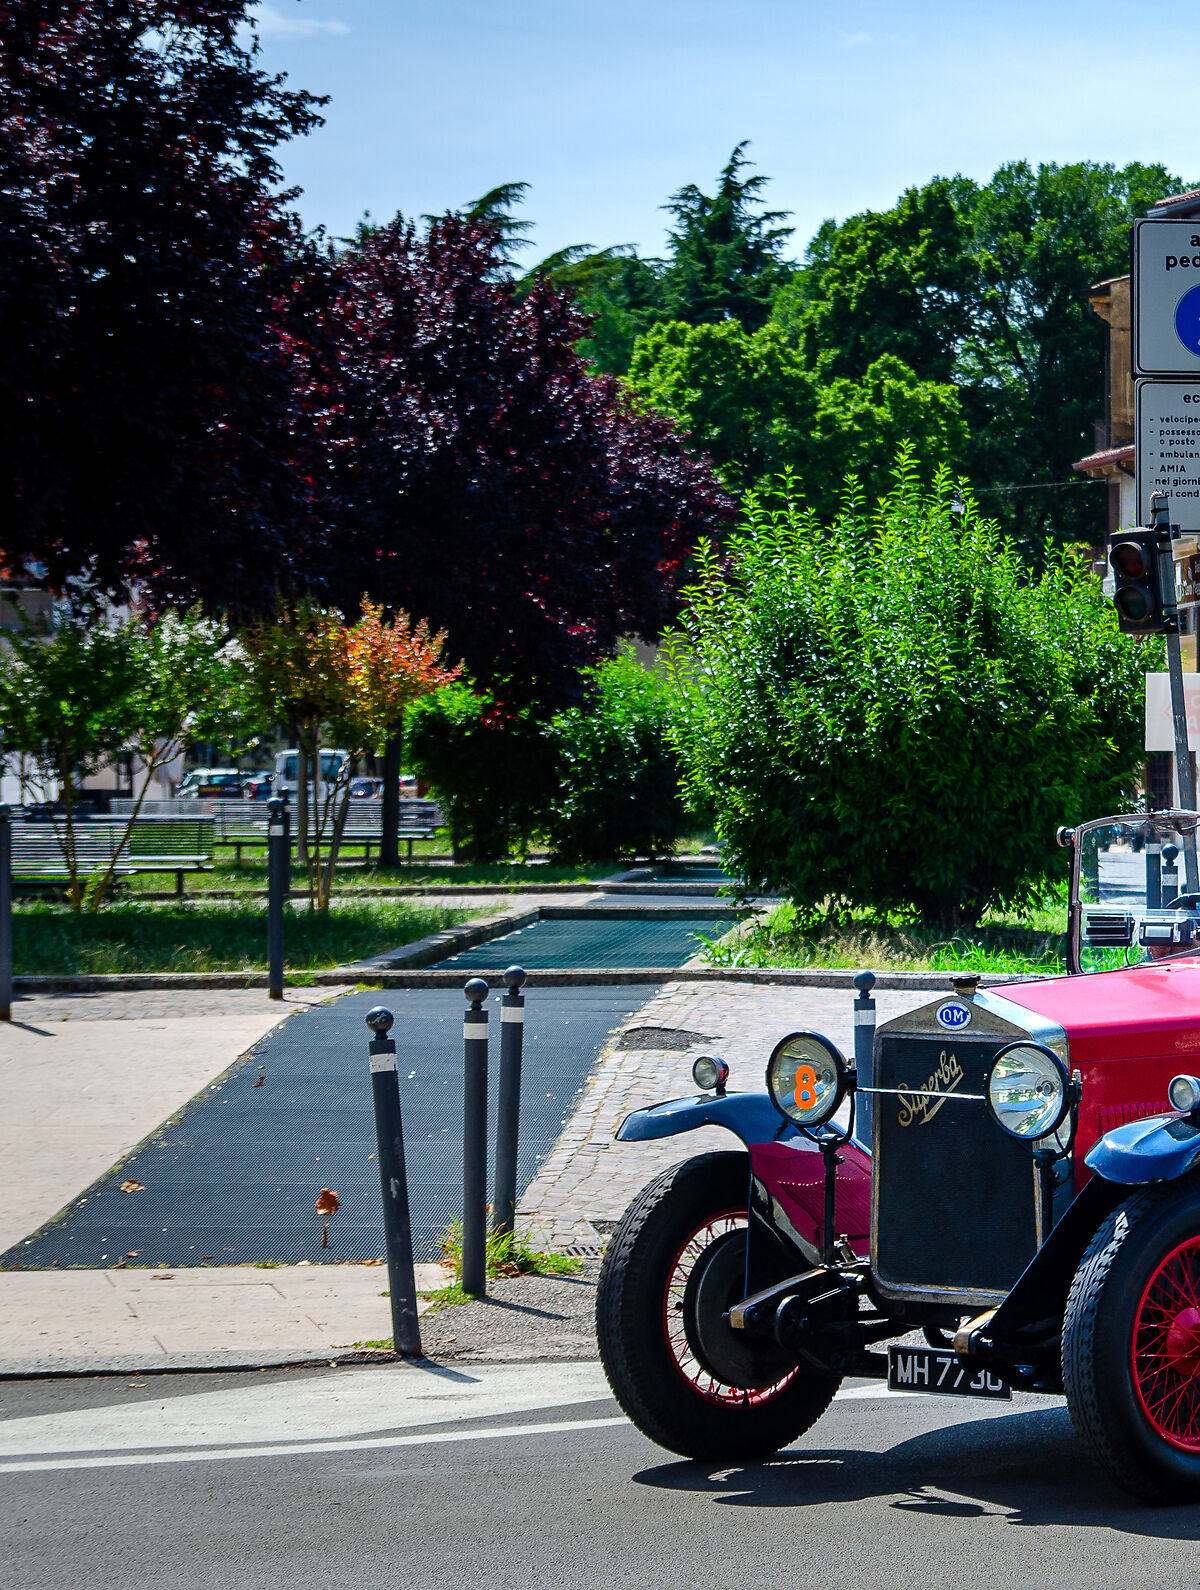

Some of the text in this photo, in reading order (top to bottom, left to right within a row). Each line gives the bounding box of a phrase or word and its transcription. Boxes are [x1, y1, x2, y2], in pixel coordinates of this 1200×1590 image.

[1169, 438, 1195, 447] posto
[1173, 477, 1200, 487] giorni
[942, 1009, 964, 1022] OM
[794, 1065, 817, 1110] 8
[898, 1050, 964, 1127] Superba
[897, 1355, 928, 1385] MH
